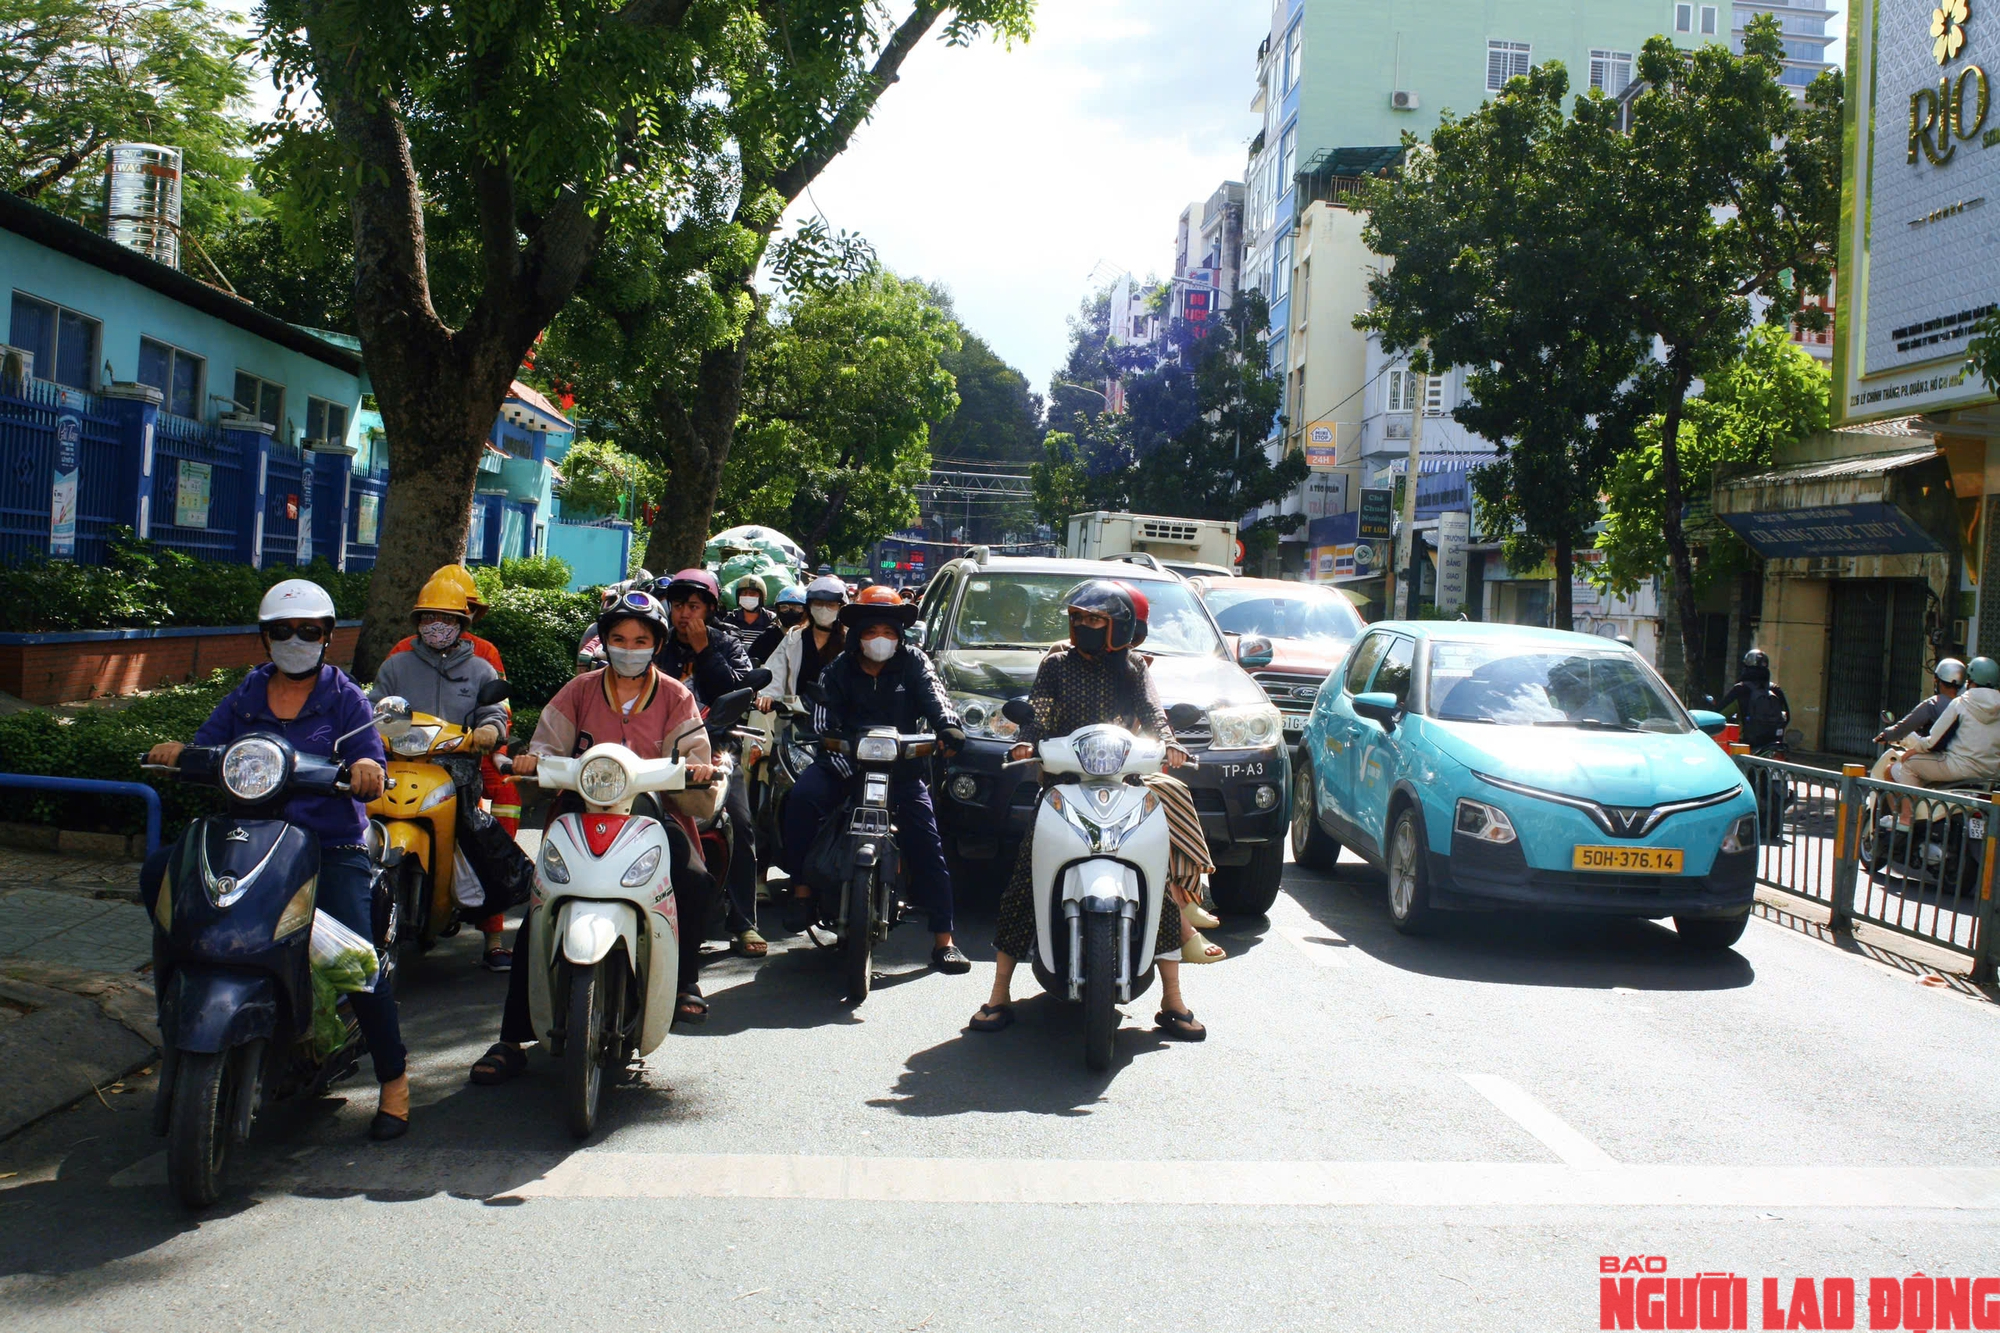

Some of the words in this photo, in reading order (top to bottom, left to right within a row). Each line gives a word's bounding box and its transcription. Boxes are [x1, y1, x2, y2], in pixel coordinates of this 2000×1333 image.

[1907, 65, 1989, 165] RIO
[1190, 294, 1206, 306] DU
[1312, 456, 1330, 464] 24H
[1444, 534, 1466, 542] TRƯỜNG
[1772, 525, 1814, 543] HÀNG
[1222, 763, 1263, 777] TP-A3
[1583, 850, 1673, 868] 50H-376.14
